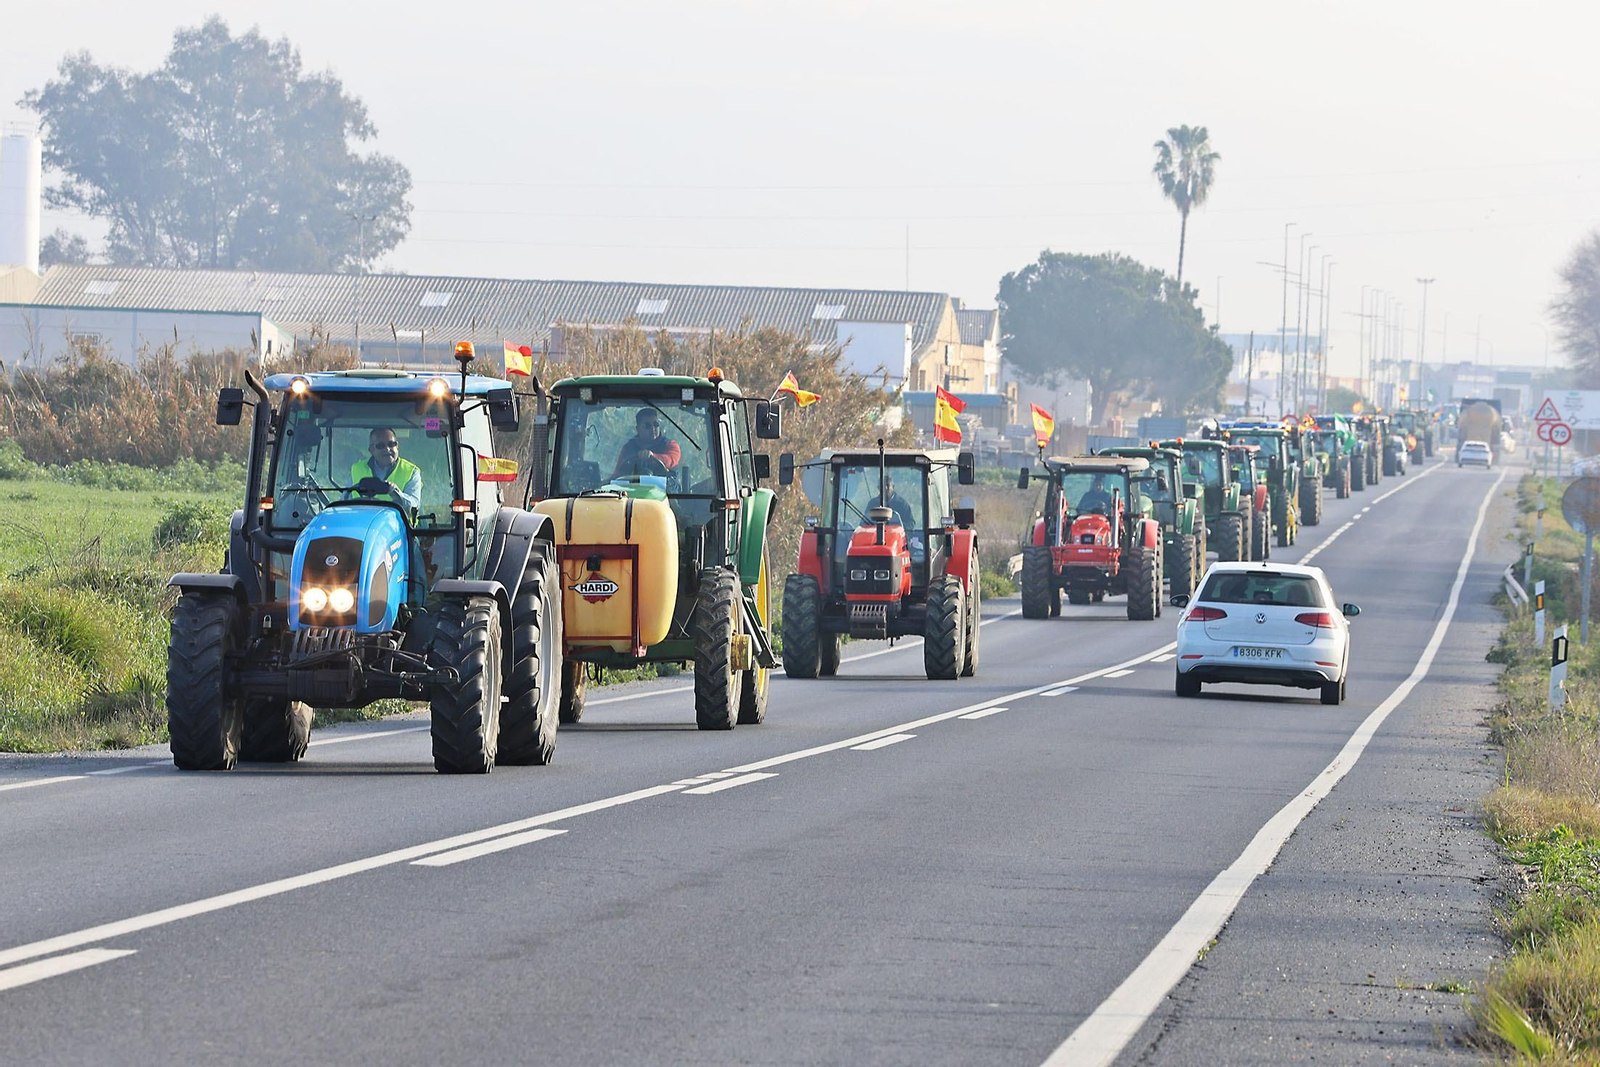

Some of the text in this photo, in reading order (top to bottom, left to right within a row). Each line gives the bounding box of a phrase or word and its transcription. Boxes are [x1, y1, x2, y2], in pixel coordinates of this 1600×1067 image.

[1554, 430, 1566, 438] 70
[580, 583, 613, 592] HARDI
[1240, 648, 1282, 658] 8306 KFK
